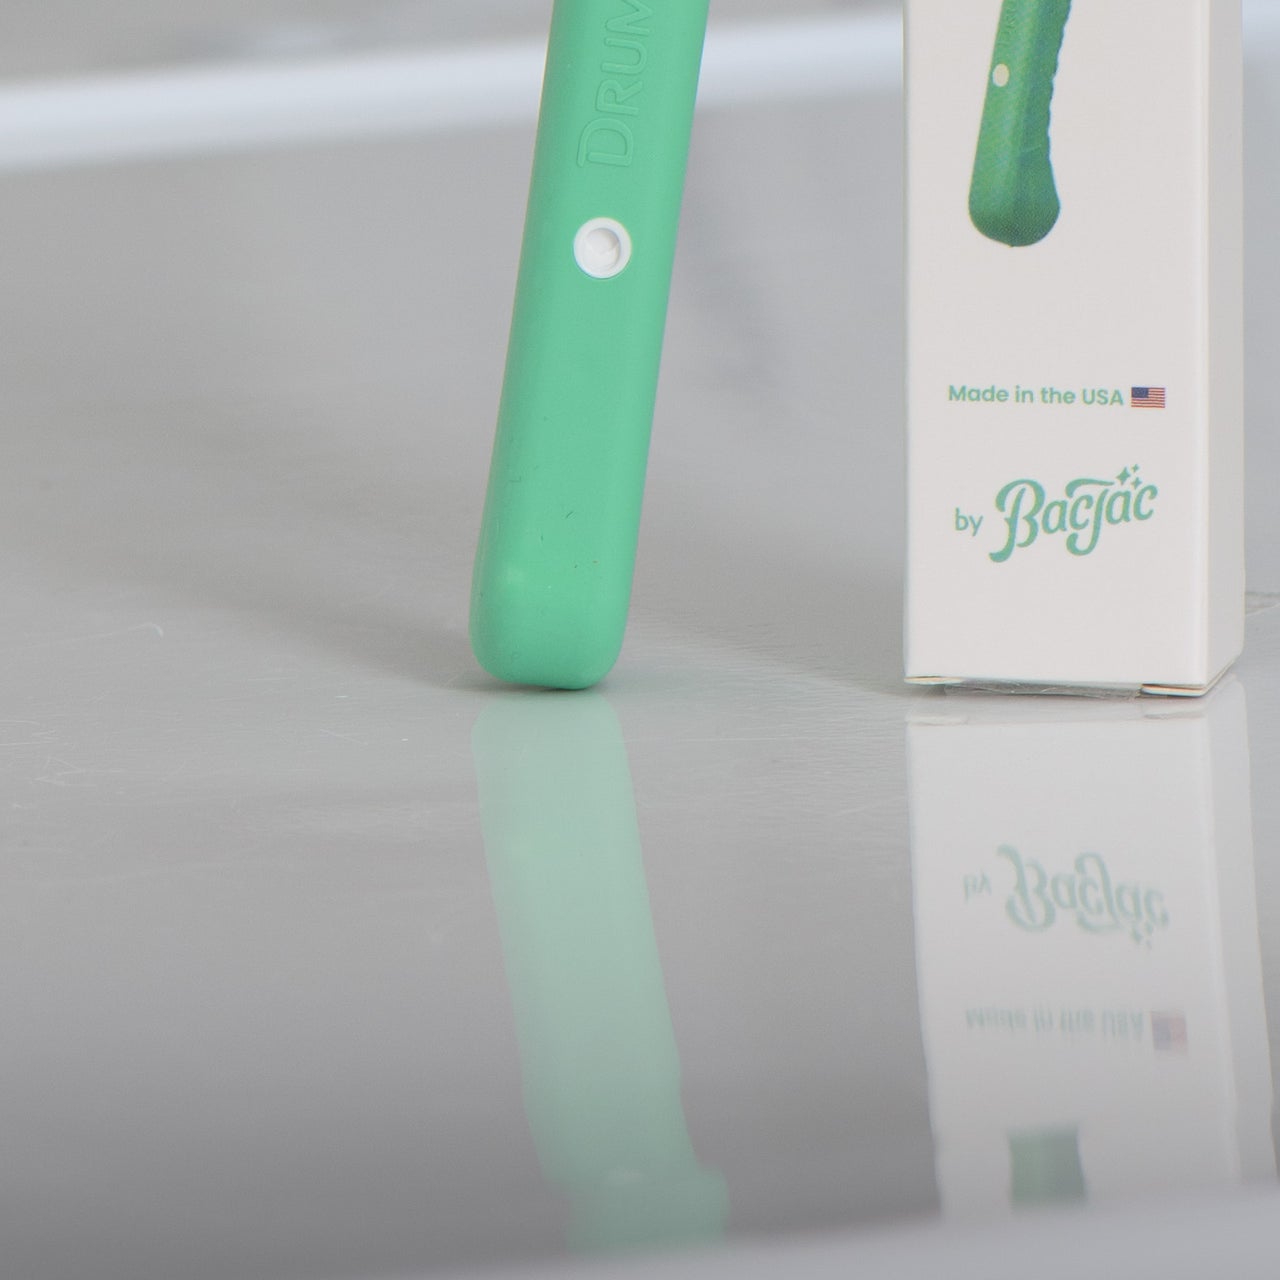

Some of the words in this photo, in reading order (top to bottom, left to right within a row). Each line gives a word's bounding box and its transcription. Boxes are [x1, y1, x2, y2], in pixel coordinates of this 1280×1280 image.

[948, 385, 1009, 403] Made
[1014, 385, 1034, 403] in
[1040, 387, 1076, 405] the
[1082, 388, 1124, 406] USA
[954, 507, 984, 536] by
